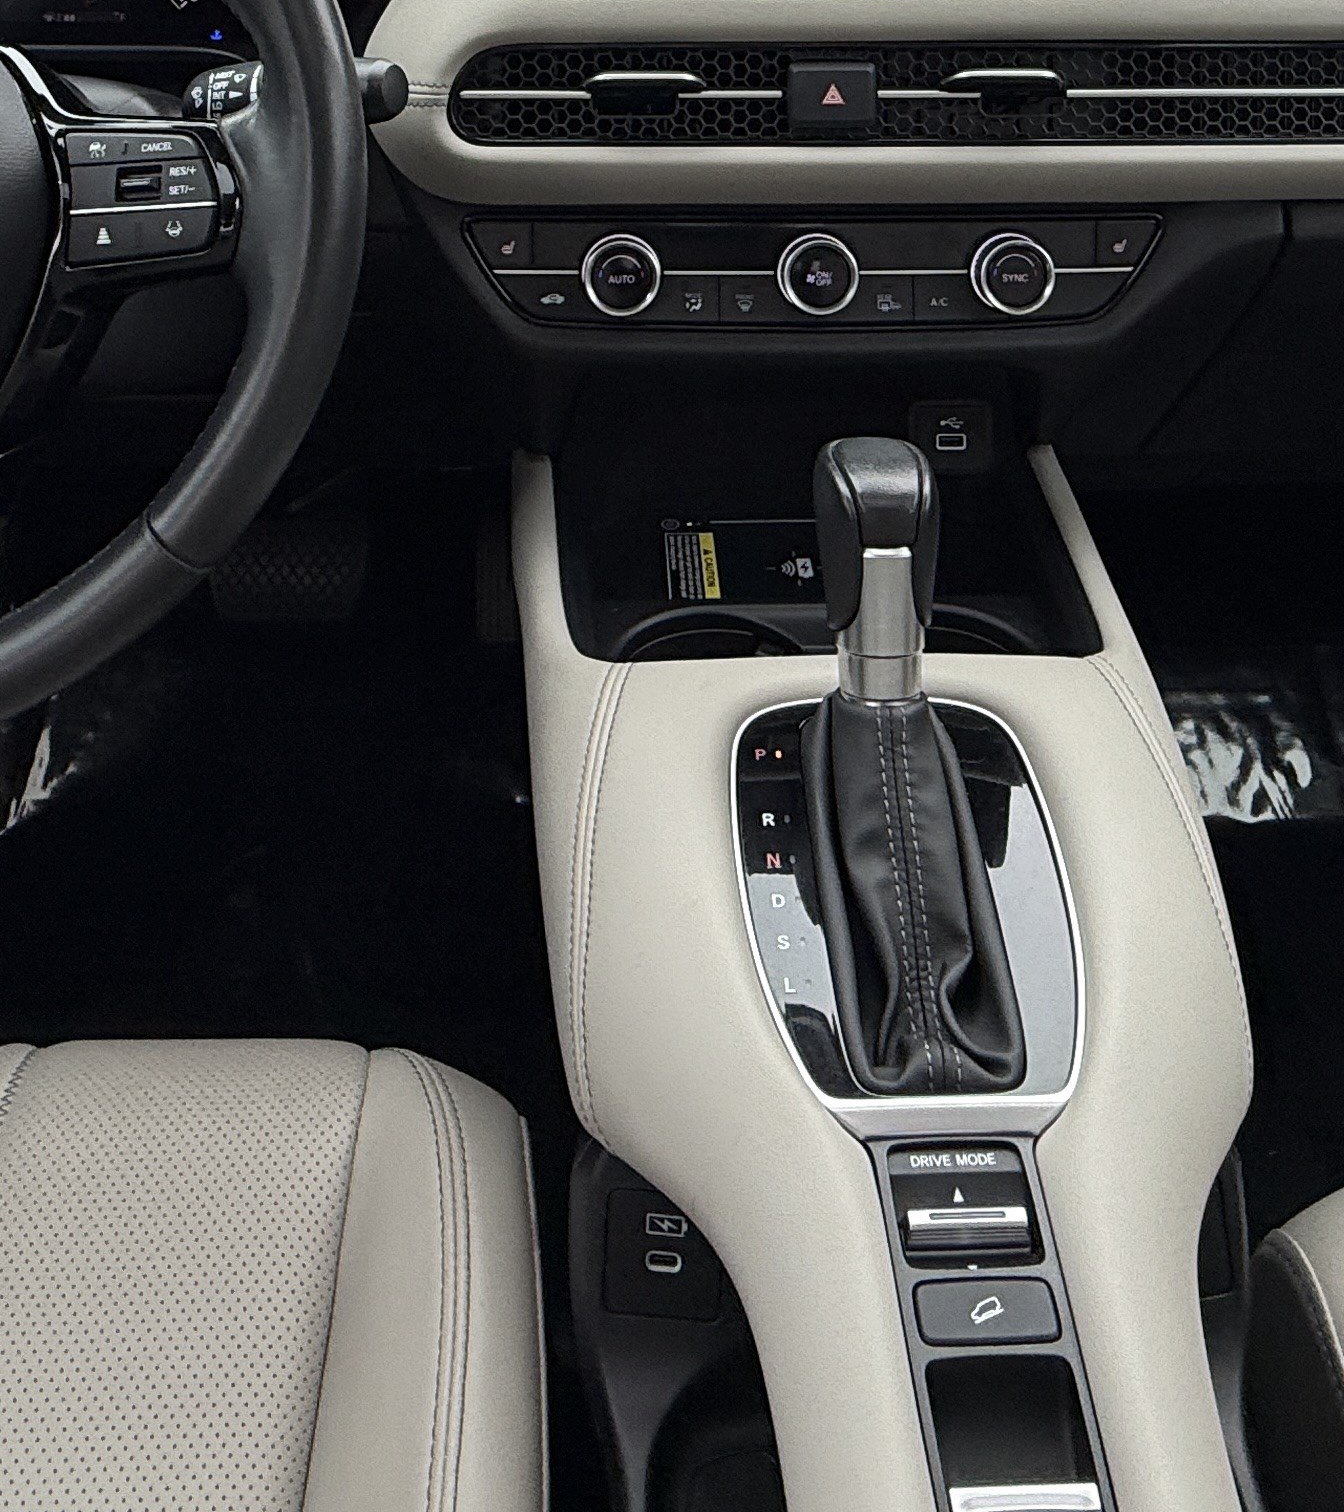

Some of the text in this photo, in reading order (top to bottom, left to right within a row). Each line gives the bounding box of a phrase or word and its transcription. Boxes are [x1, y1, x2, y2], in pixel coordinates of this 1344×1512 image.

[212, 101, 223, 110] LO
[141, 141, 173, 153] CANCEL
[607, 274, 636, 285] AUTO
[1001, 272, 1029, 283] SYNC
[930, 297, 949, 308] A/C
[704, 557, 716, 588] CAUTION
[755, 748, 766, 760] P
[762, 813, 775, 827] R
[766, 853, 781, 868] N
[771, 894, 785, 908] D
[777, 935, 790, 950] S
[784, 977, 796, 994] L
[910, 1153, 996, 1168] DRIVE MODE
